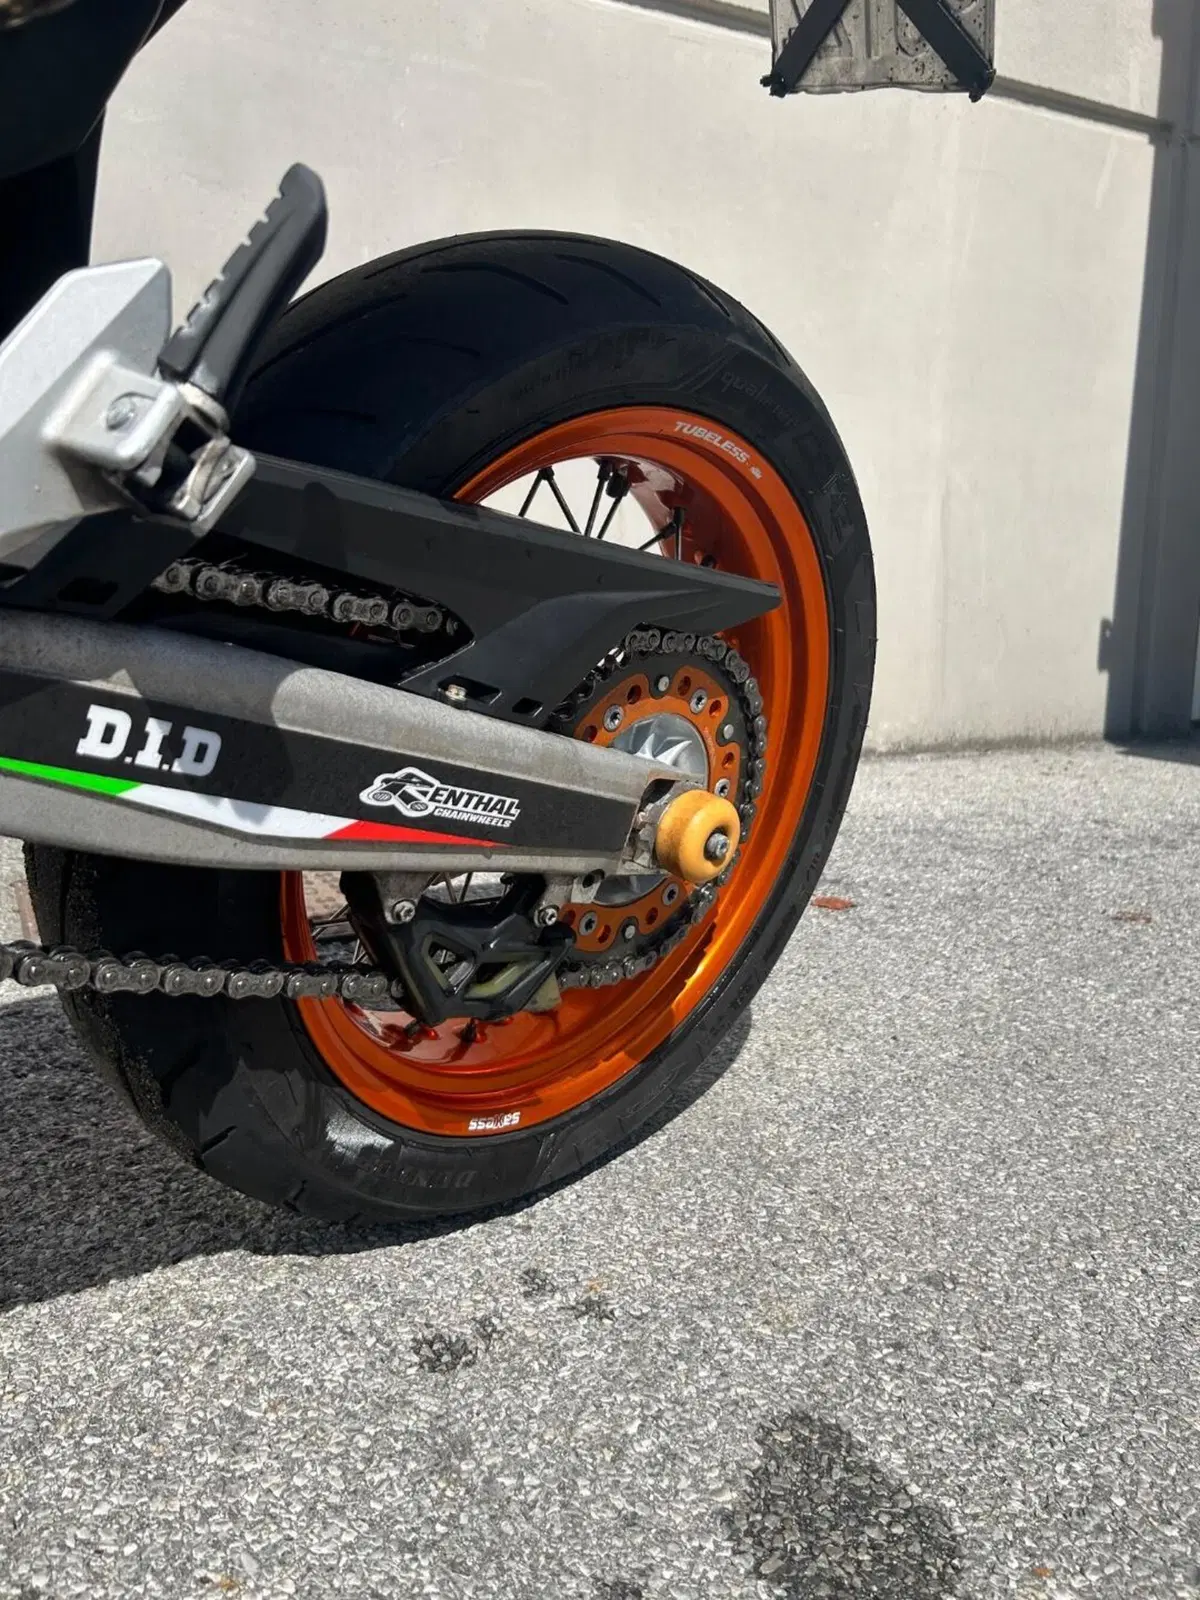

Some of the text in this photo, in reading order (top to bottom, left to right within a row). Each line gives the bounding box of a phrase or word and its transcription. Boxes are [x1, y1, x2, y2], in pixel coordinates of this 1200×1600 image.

[674, 421, 749, 464] TUBELESS
[76, 704, 222, 777] D.I.D
[434, 806, 512, 828] CHAINWHEELS
